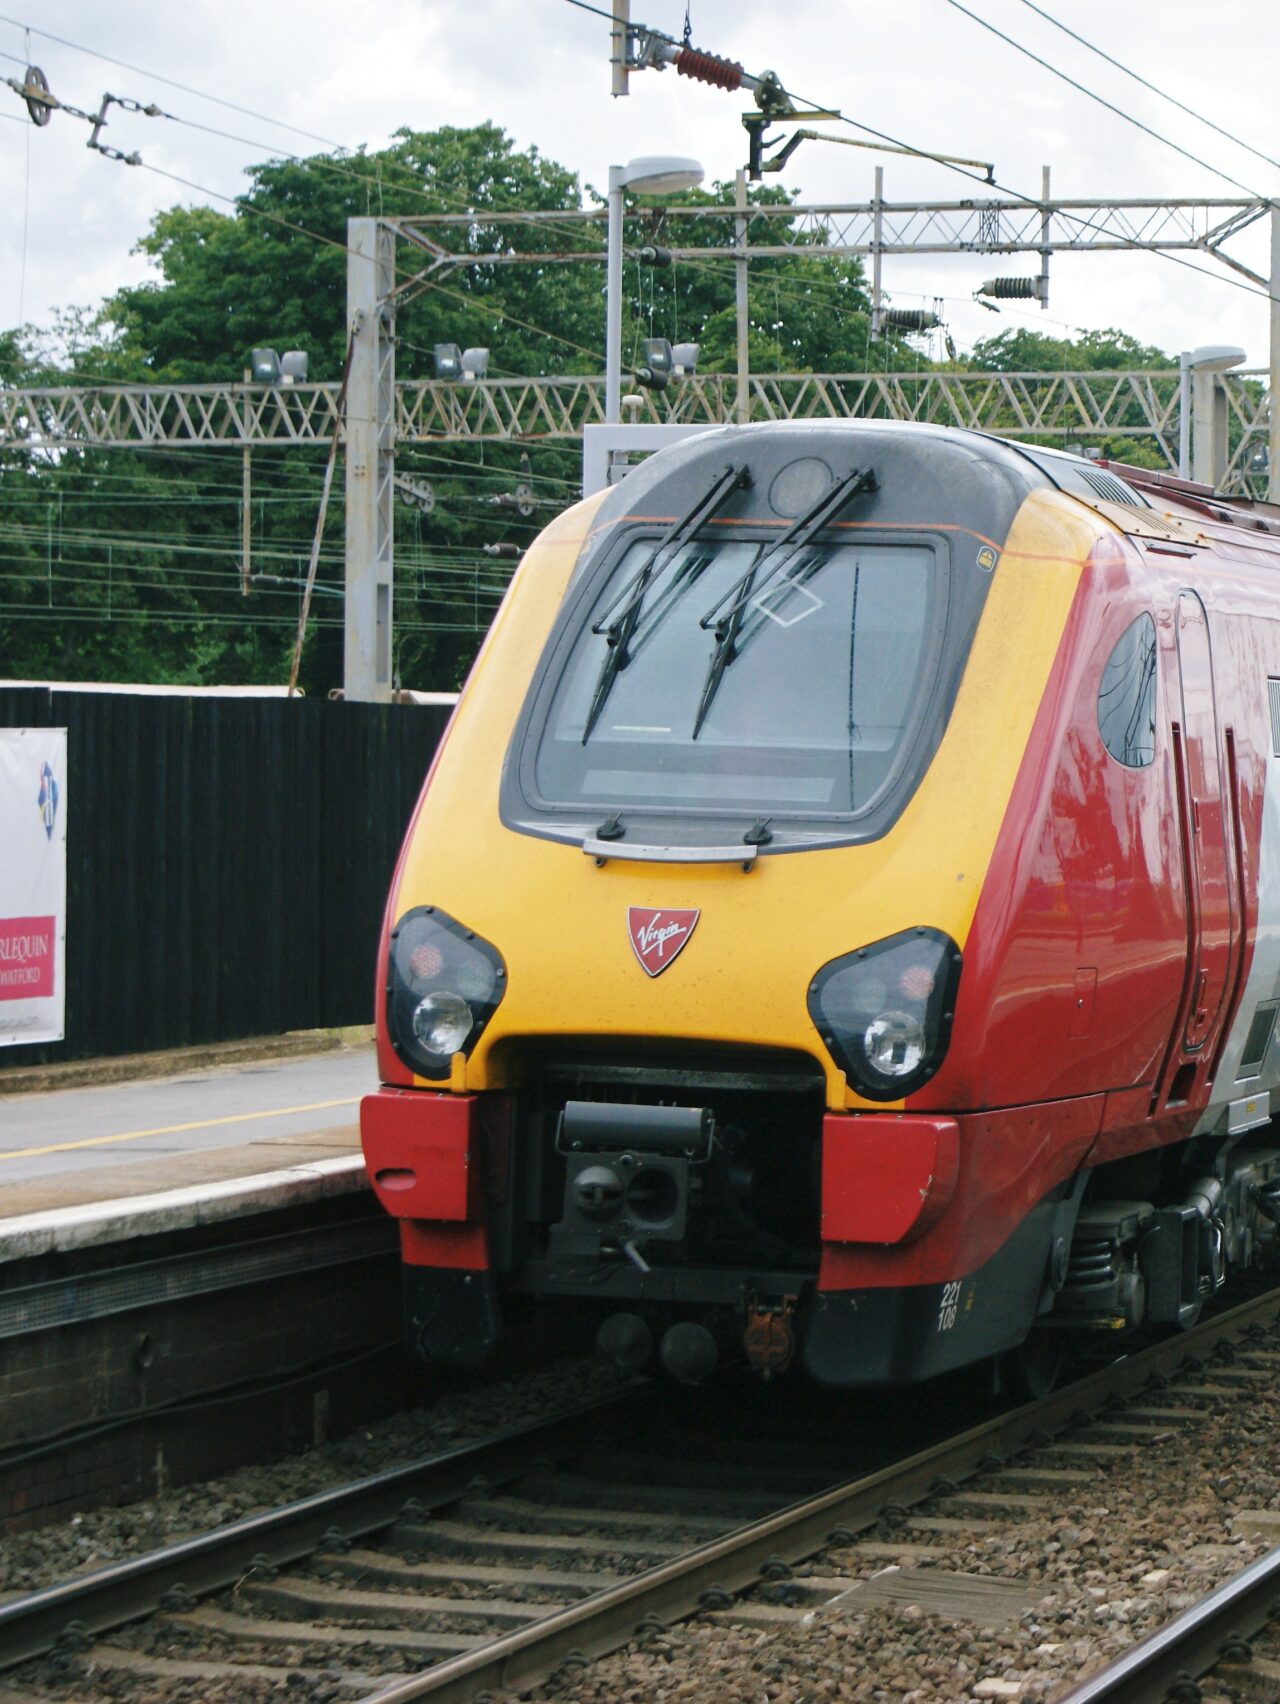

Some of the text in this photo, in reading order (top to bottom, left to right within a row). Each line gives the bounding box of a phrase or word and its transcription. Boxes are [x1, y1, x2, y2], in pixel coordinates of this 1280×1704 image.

[637, 913, 686, 956] Virgin
[941, 1281, 962, 1306] 221
[937, 1306, 957, 1332] 108
